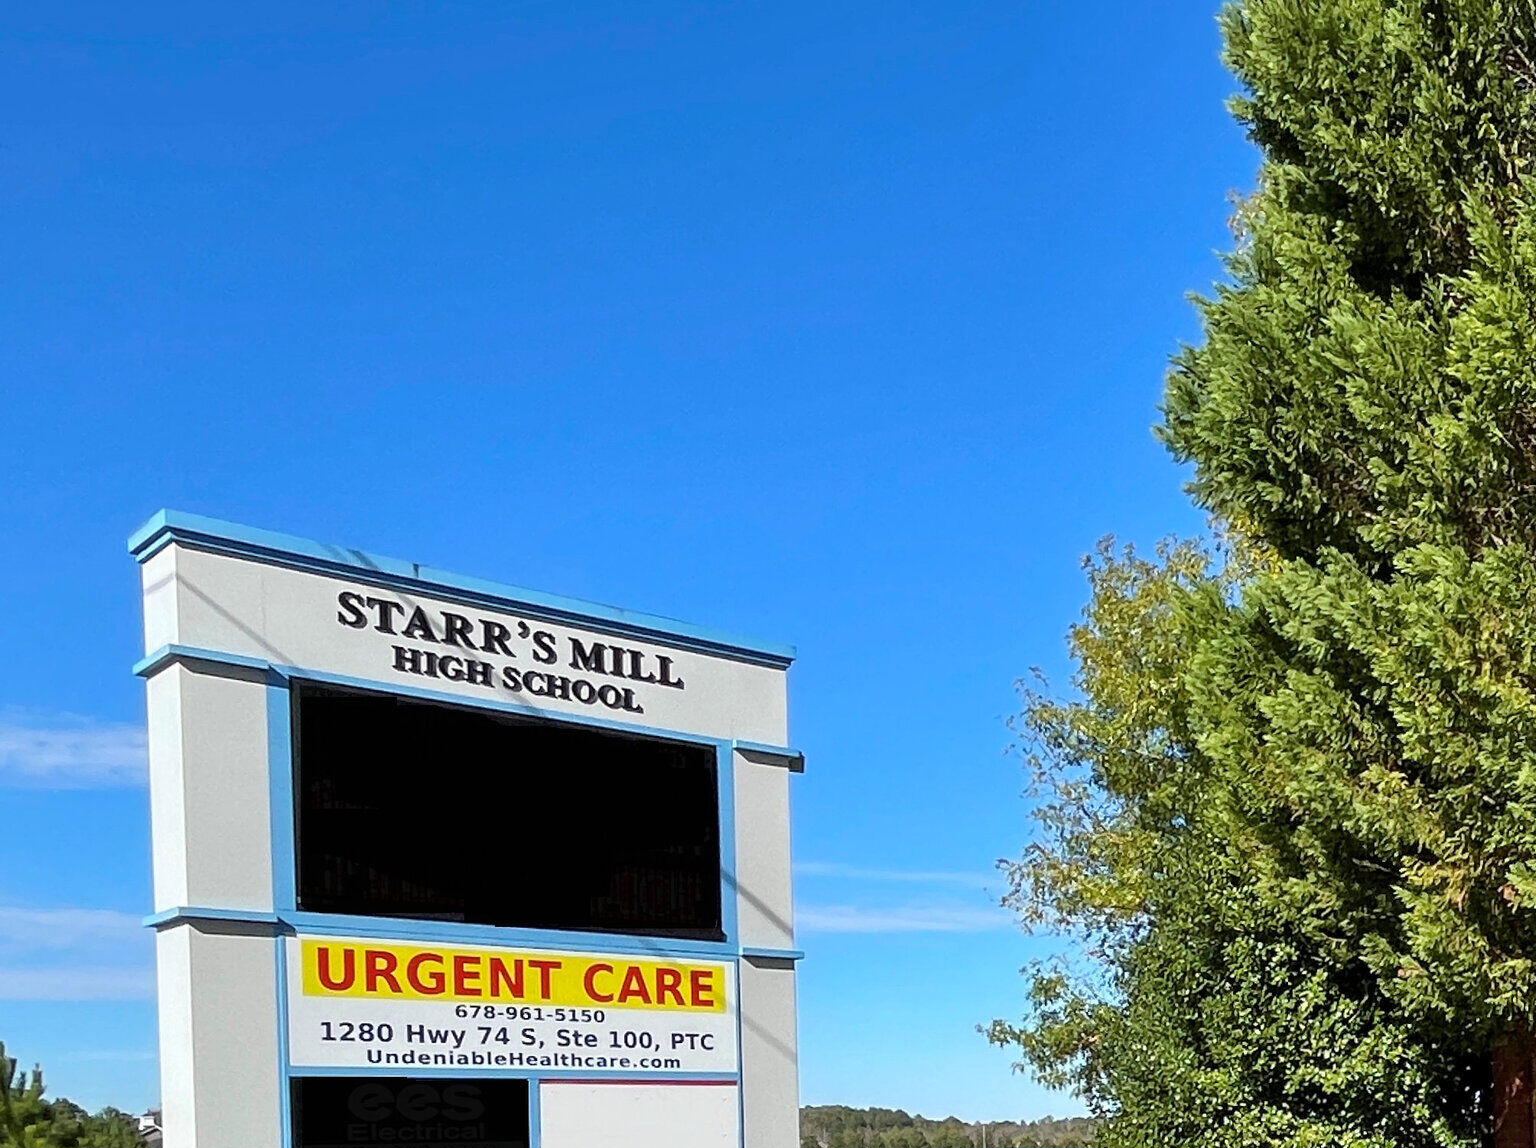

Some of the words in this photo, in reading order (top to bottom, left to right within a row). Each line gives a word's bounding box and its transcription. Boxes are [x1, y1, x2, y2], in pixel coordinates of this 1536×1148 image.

[337, 590, 558, 665] STARR'S
[569, 636, 685, 690] MILL
[391, 645, 495, 688] HIGH
[502, 666, 645, 714] SCHOOL
[316, 946, 562, 1000] URGENT
[583, 962, 714, 1007] CARE
[455, 1004, 605, 1024] 678-961-5150
[320, 1021, 394, 1043] 1280
[406, 1024, 466, 1049] Hwy
[477, 1026, 510, 1045] 74
[521, 1028, 545, 1049] S,
[556, 1029, 598, 1048] Ste
[609, 1031, 660, 1052] 100,
[671, 1033, 714, 1051] PTC
[366, 1049, 681, 1069] UndeniableHealthcare.com
[347, 1083, 486, 1121] ees
[347, 1122, 486, 1142] Electrical
